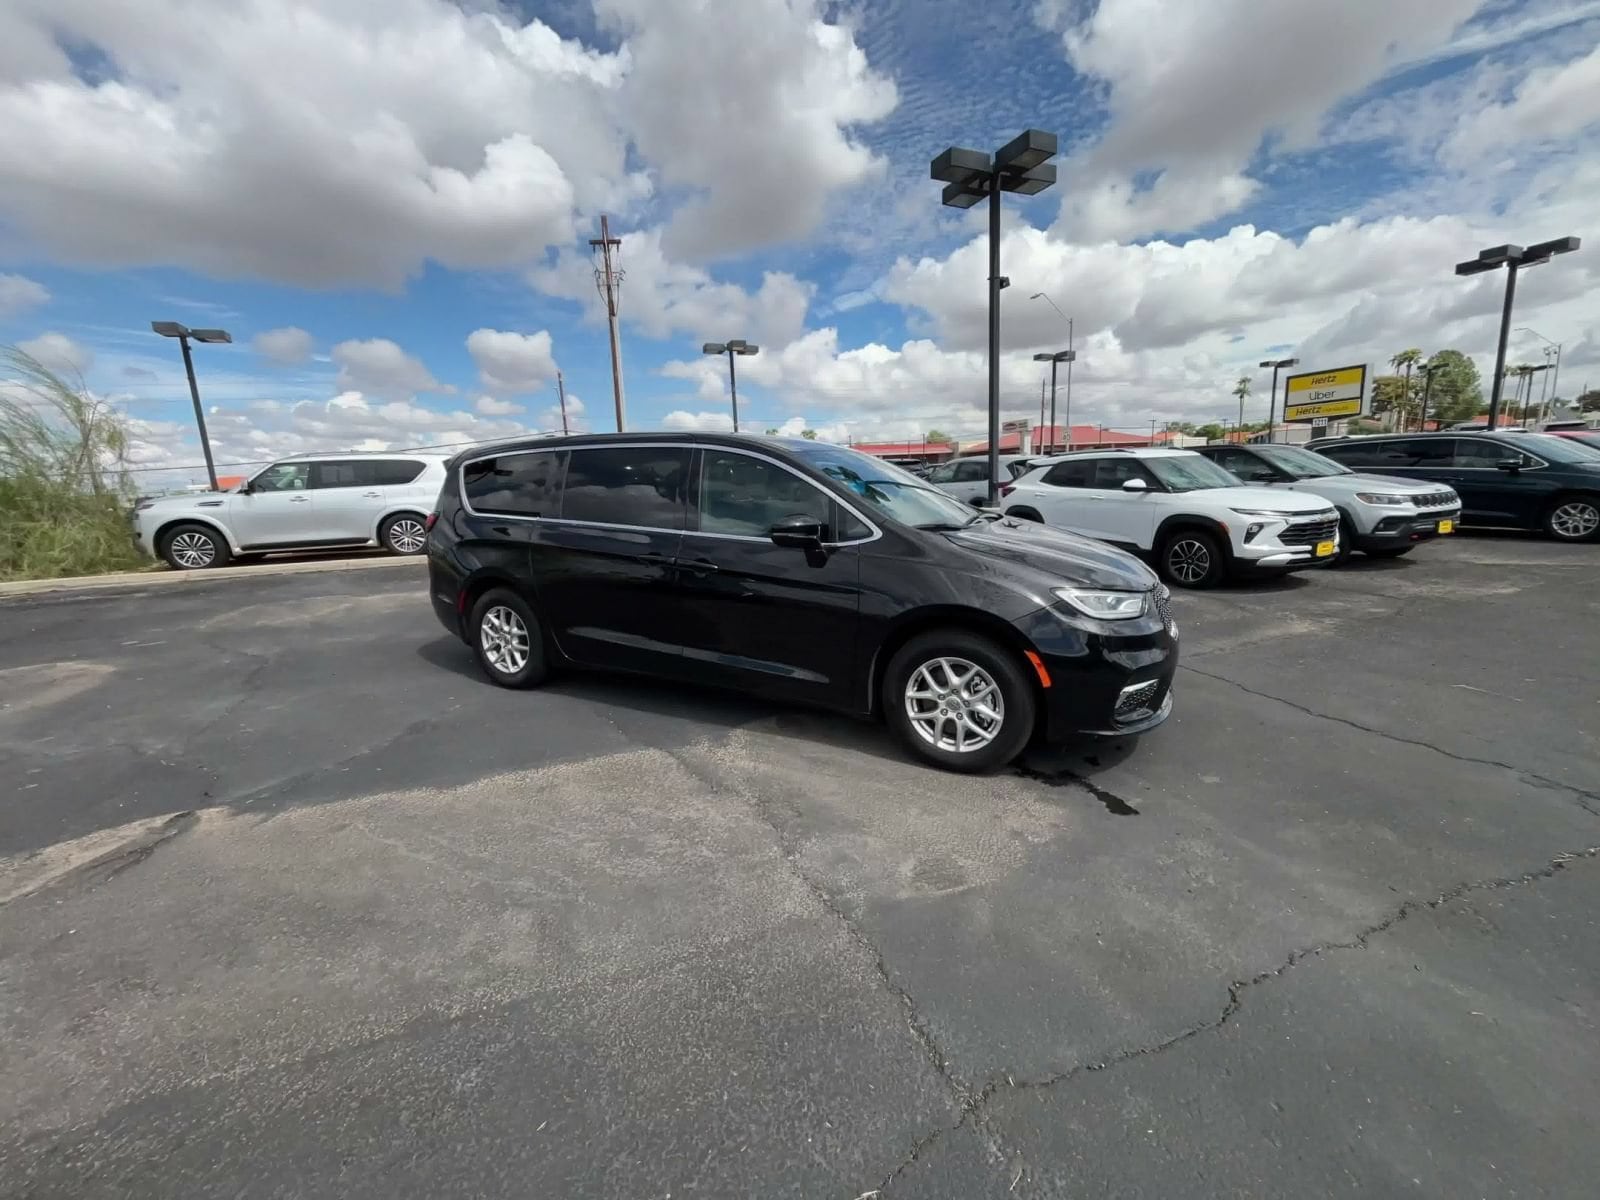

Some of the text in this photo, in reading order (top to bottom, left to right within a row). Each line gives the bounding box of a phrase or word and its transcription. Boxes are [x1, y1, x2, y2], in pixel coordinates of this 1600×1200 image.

[1311, 376, 1337, 385] Hertz
[1309, 390, 1336, 400] Uber
[1296, 406, 1322, 416] Hertz
